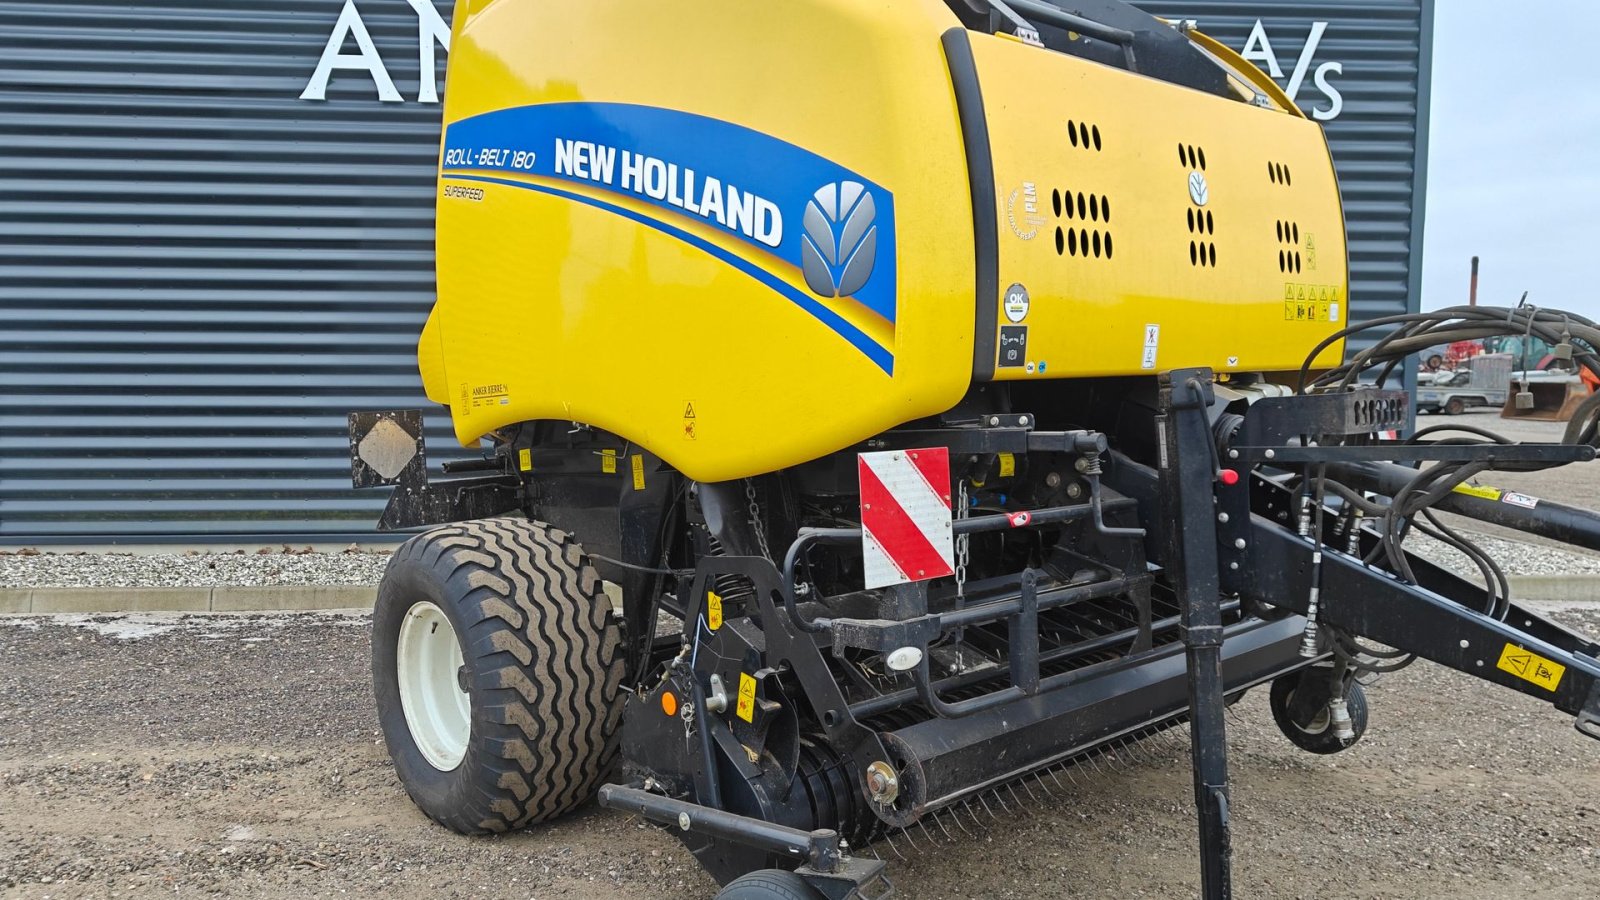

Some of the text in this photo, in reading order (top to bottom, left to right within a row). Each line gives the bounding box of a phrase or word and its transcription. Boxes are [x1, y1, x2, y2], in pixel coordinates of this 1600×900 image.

[444, 148, 536, 170] ROLL-BELT 180
[443, 185, 485, 201] SUPERFEED
[554, 137, 783, 248] NEW HOLLAND
[1023, 182, 1037, 213] PLM
[1009, 293, 1024, 304] OK
